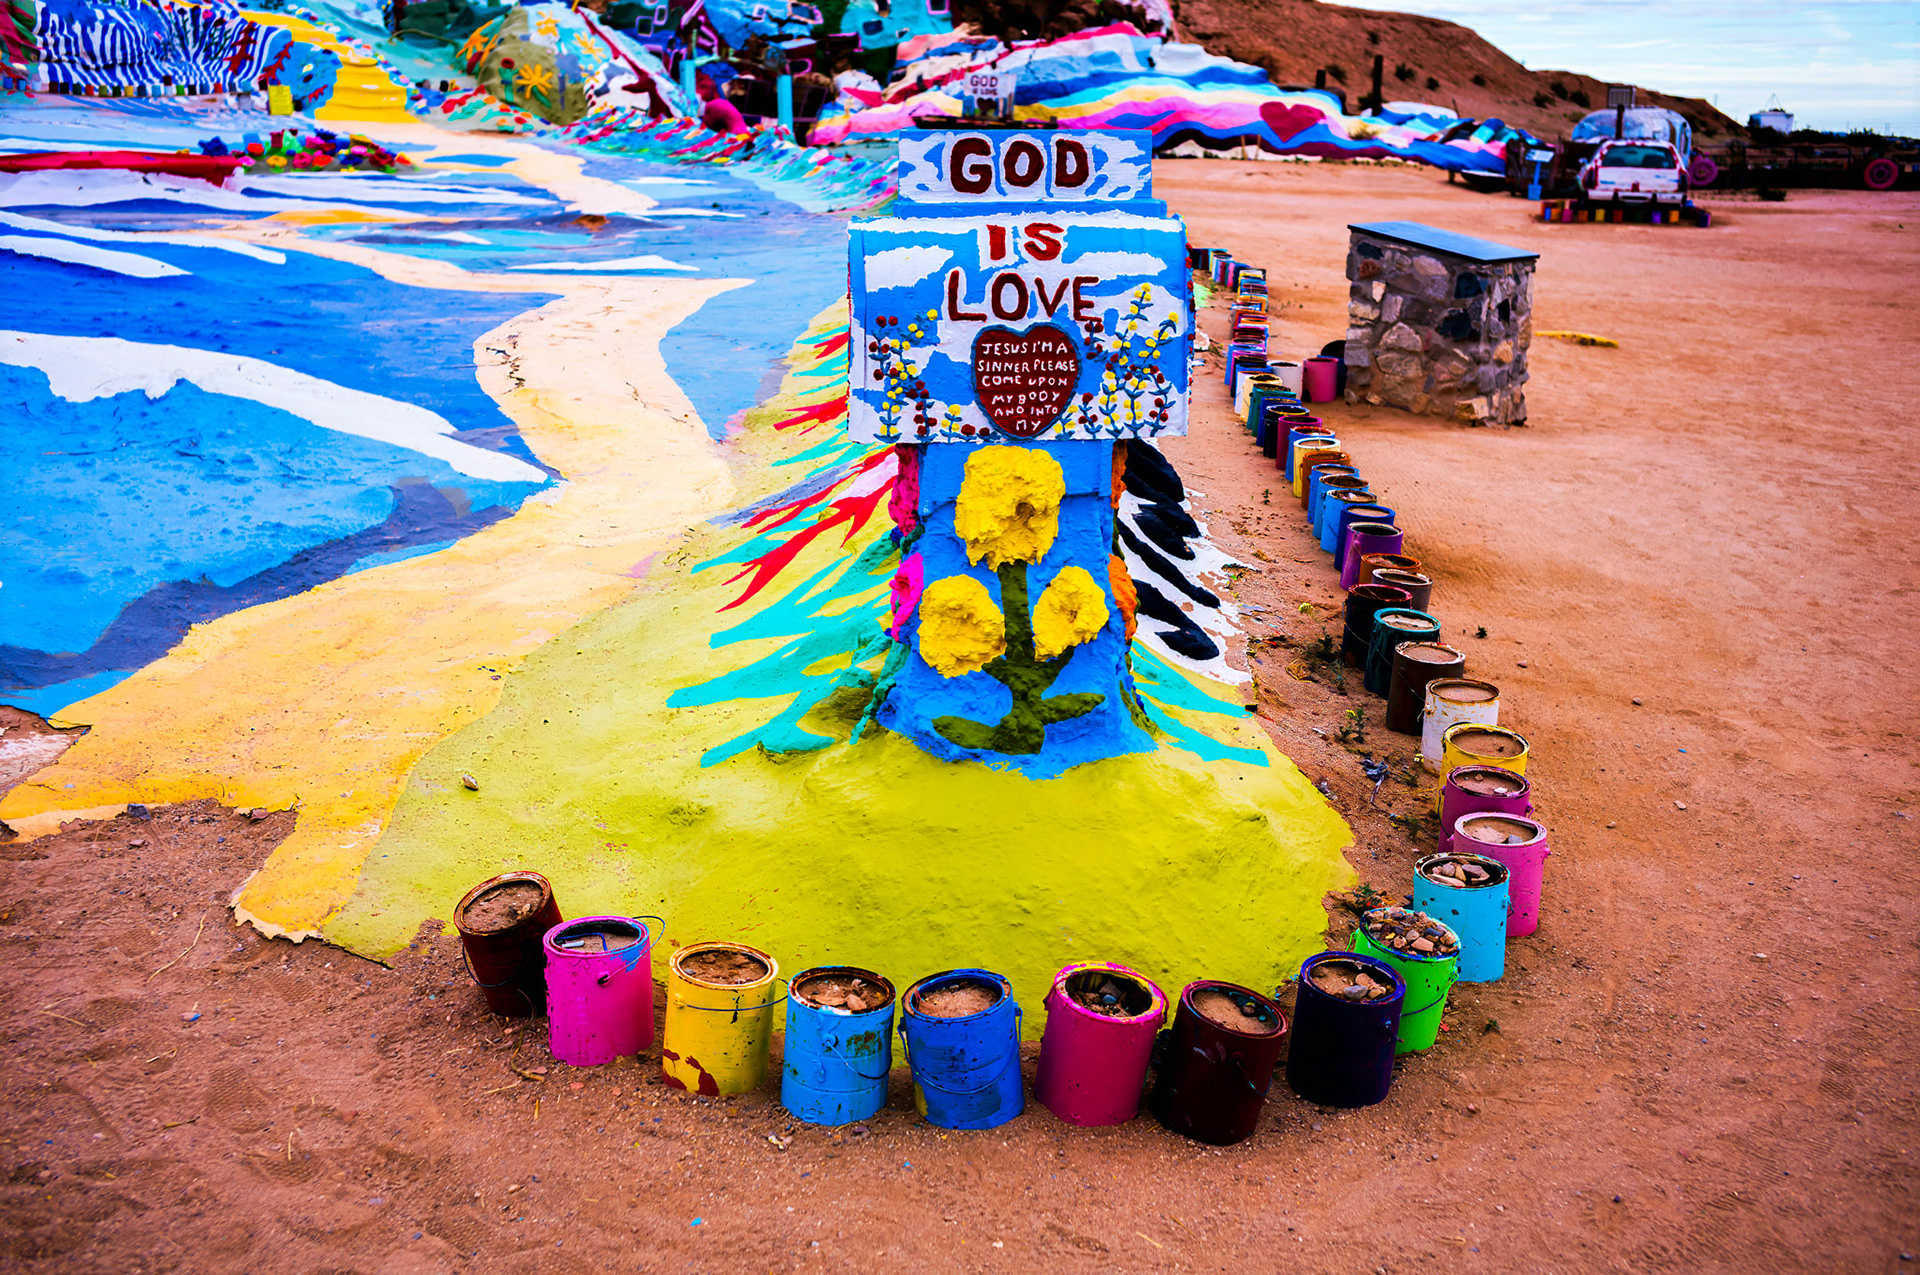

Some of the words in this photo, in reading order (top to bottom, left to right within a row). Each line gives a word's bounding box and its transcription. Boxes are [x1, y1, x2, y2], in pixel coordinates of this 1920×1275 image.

[970, 75, 999, 88] GOD
[950, 137, 1090, 194] GOD
[987, 222, 1064, 261] IS
[948, 270, 1103, 322] LOVE
[981, 342, 1028, 355] JESUS
[1032, 340, 1052, 353] I'M
[1056, 342, 1068, 354] A
[977, 360, 1030, 373] SINNER
[1033, 359, 1076, 372] PLEASE
[981, 375, 1022, 387] COME
[1028, 376, 1067, 387] UPON
[991, 395, 1014, 405] MY
[1030, 404, 1058, 417] INTO
[1015, 419, 1041, 431] MY
